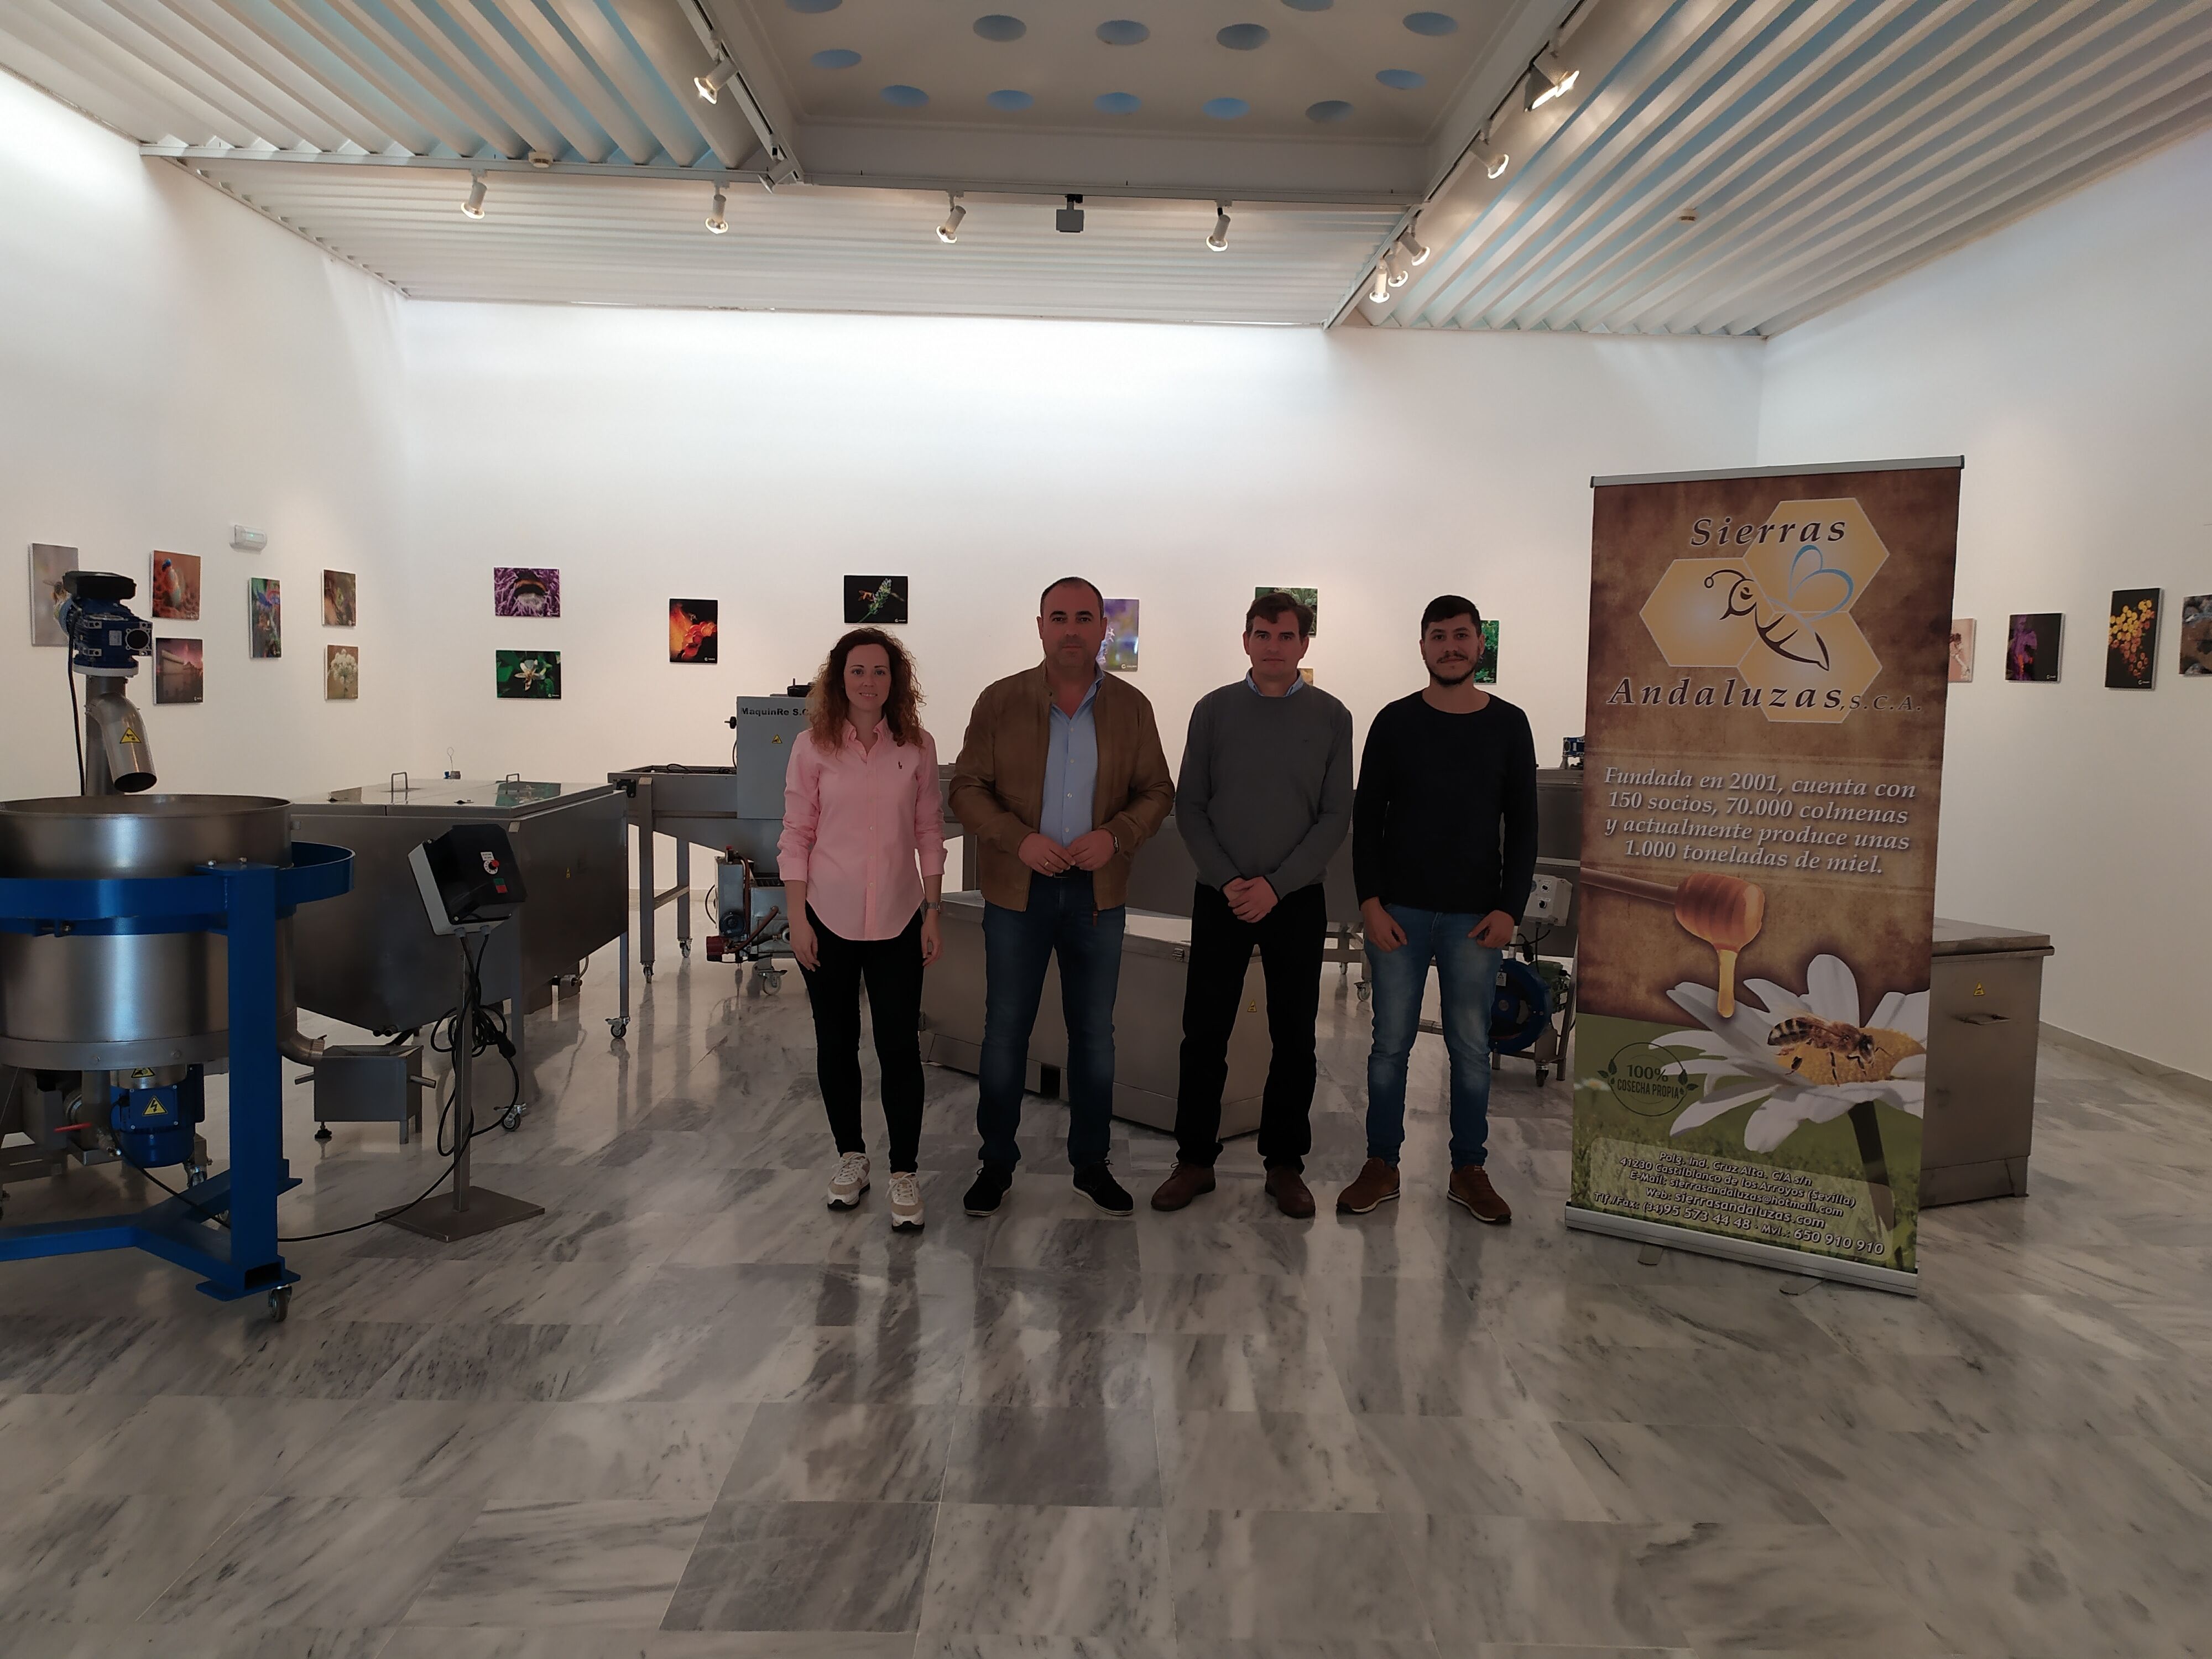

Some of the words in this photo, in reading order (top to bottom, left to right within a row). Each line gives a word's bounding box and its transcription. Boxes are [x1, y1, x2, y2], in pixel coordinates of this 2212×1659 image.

[1691, 517, 1846, 546] Sierras
[742, 708, 790, 717] MaquinRe
[1604, 766, 1693, 787] Fundada
[1699, 775, 1723, 789] en
[1729, 773, 1783, 795] 2001,
[1792, 779, 1867, 796] cuenta
[1875, 783, 1916, 798] con
[1609, 791, 1642, 808] 150
[1648, 795, 1717, 816] socios,
[1726, 797, 1793, 817] 70.000
[1799, 802, 1908, 823] colmenas
[1605, 818, 1618, 836] y
[1624, 817, 1753, 839] actualmente
[1757, 826, 1848, 846] produce
[1854, 833, 1911, 849] unas
[1625, 839, 1676, 858] 1.000
[1683, 844, 1788, 867] toneladas
[1795, 851, 1820, 868] de
[1827, 854, 1882, 873] miel.
[1618, 1079, 1650, 1095] COSECHA
[1652, 1084, 1679, 1099] PROPIA
[1627, 1065, 1668, 1082] 100%
[1620, 1157, 1652, 1171] 41230
[1655, 1163, 1721, 1183] Castilblanco
[1724, 1175, 1739, 1186] de
[1741, 1177, 1757, 1189] los
[1760, 1182, 1804, 1198] Arroyos
[1807, 1190, 1856, 1208] (Sevilla)
[1660, 1152, 1686, 1166] Polg.
[1689, 1157, 1709, 1169] Ind.
[1713, 1161, 1739, 1173] Cruz
[1740, 1165, 1768, 1178] Alta.
[1772, 1171, 1791, 1183] C/A
[1794, 1175, 1812, 1187] s/n
[1630, 1171, 1667, 1186] E-Mail:
[1670, 1178, 1844, 1217] sierrasandaluzas@hotmail.com
[1646, 1187, 1672, 1201] Web:
[1674, 1192, 1825, 1229] sierrasandaluzas.com
[1594, 1192, 1640, 1210] Tlf./Fax:
[1643, 1202, 1681, 1217] (34)95
[1684, 1207, 1709, 1222] 573
[1712, 1214, 1730, 1226] 44
[1734, 1217, 1752, 1230] 48
[1761, 1224, 1791, 1239] Mvl.:
[1793, 1229, 1822, 1243] 650
[1825, 1234, 1853, 1249] 910
[1856, 1240, 1885, 1255] 910
